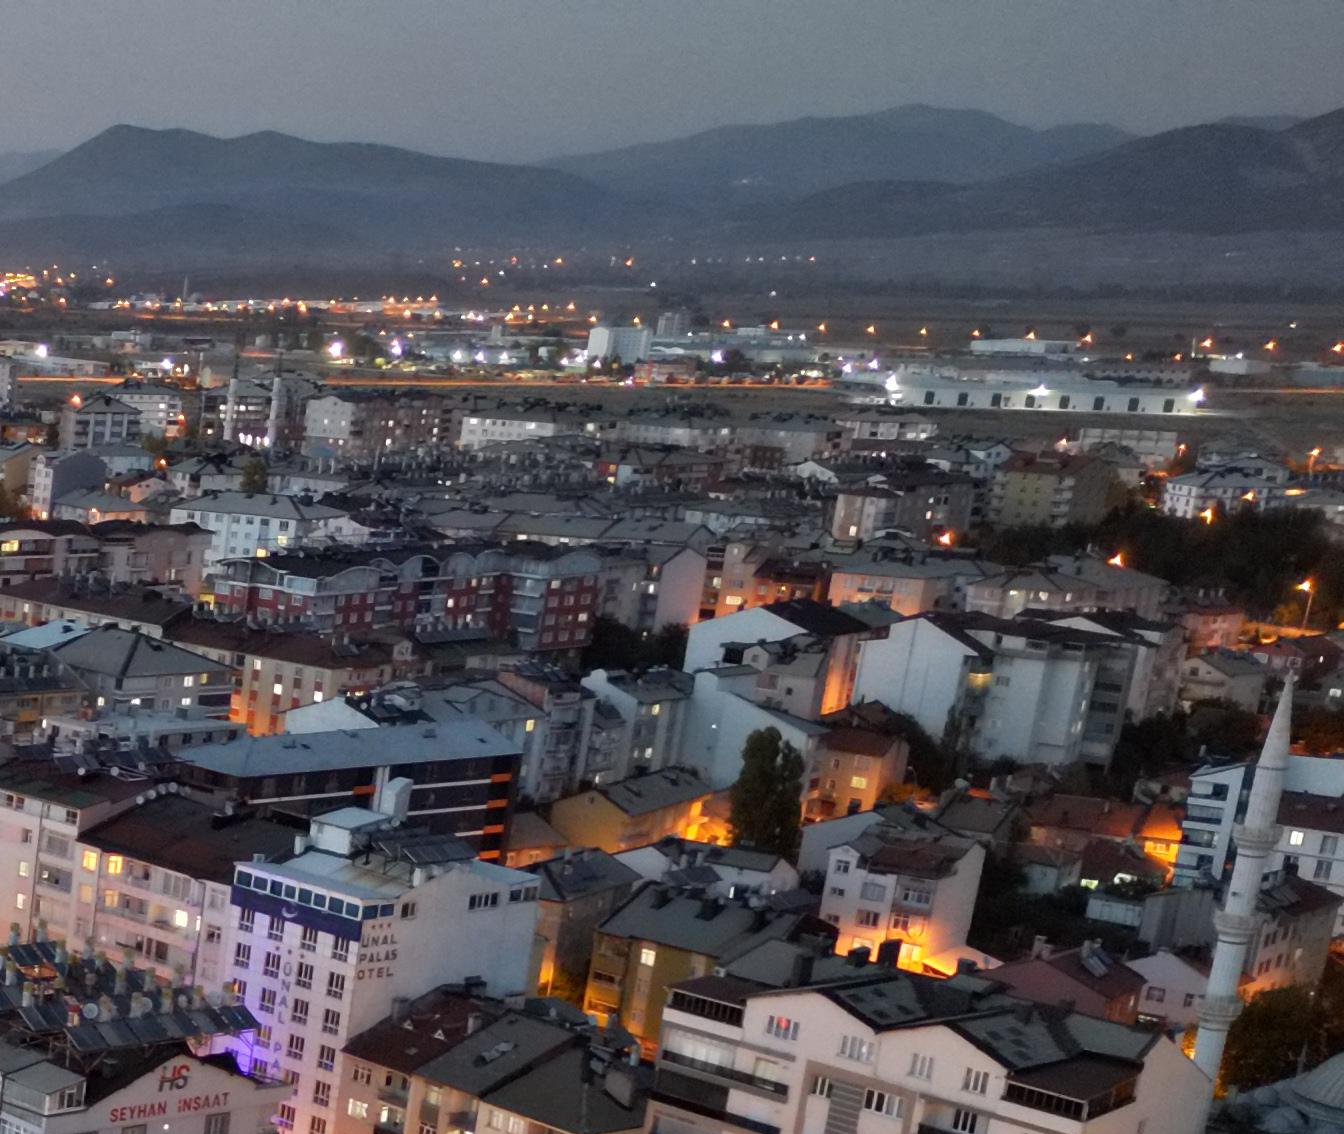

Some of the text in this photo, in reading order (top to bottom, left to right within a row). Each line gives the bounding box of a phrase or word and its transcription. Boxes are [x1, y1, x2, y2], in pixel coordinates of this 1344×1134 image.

[361, 933, 398, 948] ÜNAL
[359, 949, 398, 964] PALAS
[357, 966, 394, 980] OTEL
[110, 1101, 167, 1122] SEYHAN
